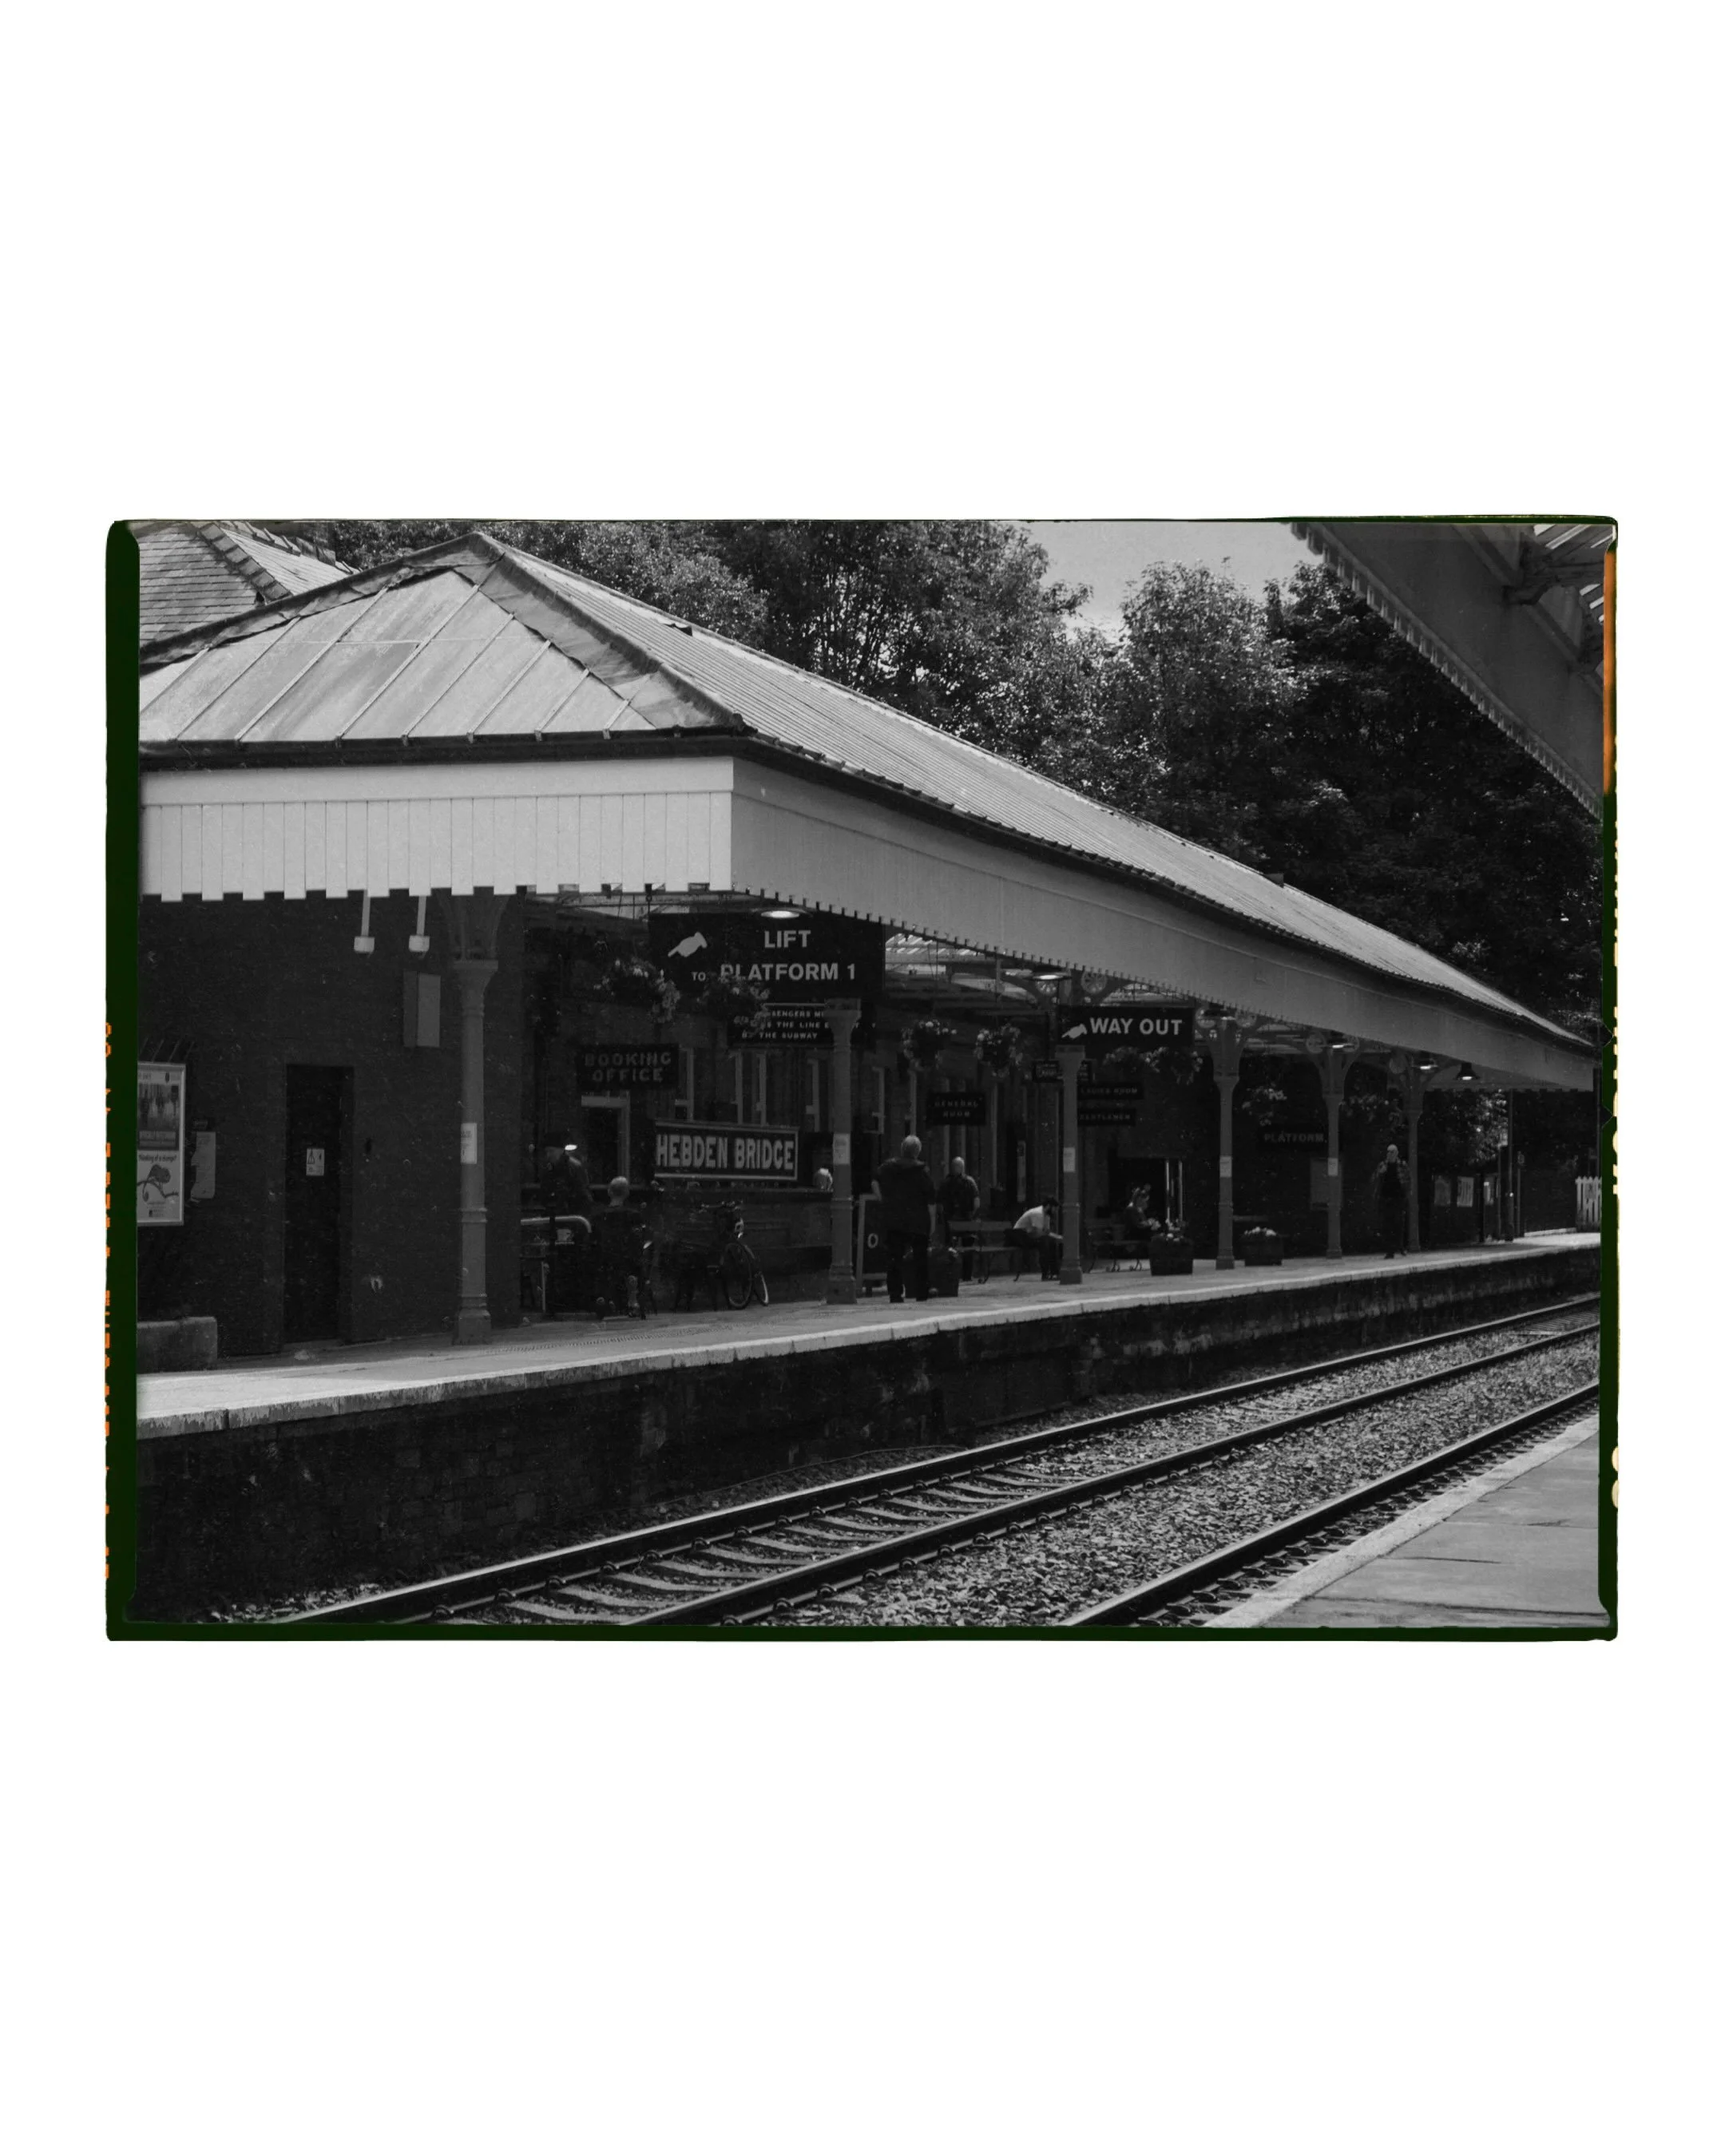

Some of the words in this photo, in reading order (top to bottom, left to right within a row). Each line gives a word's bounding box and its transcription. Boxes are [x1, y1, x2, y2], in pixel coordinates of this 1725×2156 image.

[763, 929, 811, 949] LIFT
[691, 971, 706, 982] TO
[720, 962, 839, 981] PLATFORM
[847, 963, 855, 981] 1
[776, 1021, 795, 1029] THE
[1089, 1017, 1134, 1036] WAY
[1139, 1017, 1184, 1036] OUT
[759, 1031, 777, 1040] THE
[584, 1051, 672, 1067] BOOKING
[592, 1067, 664, 1083] OFFICE
[655, 1133, 728, 1169] HEBDEN
[734, 1137, 795, 1171] BRIDGE
